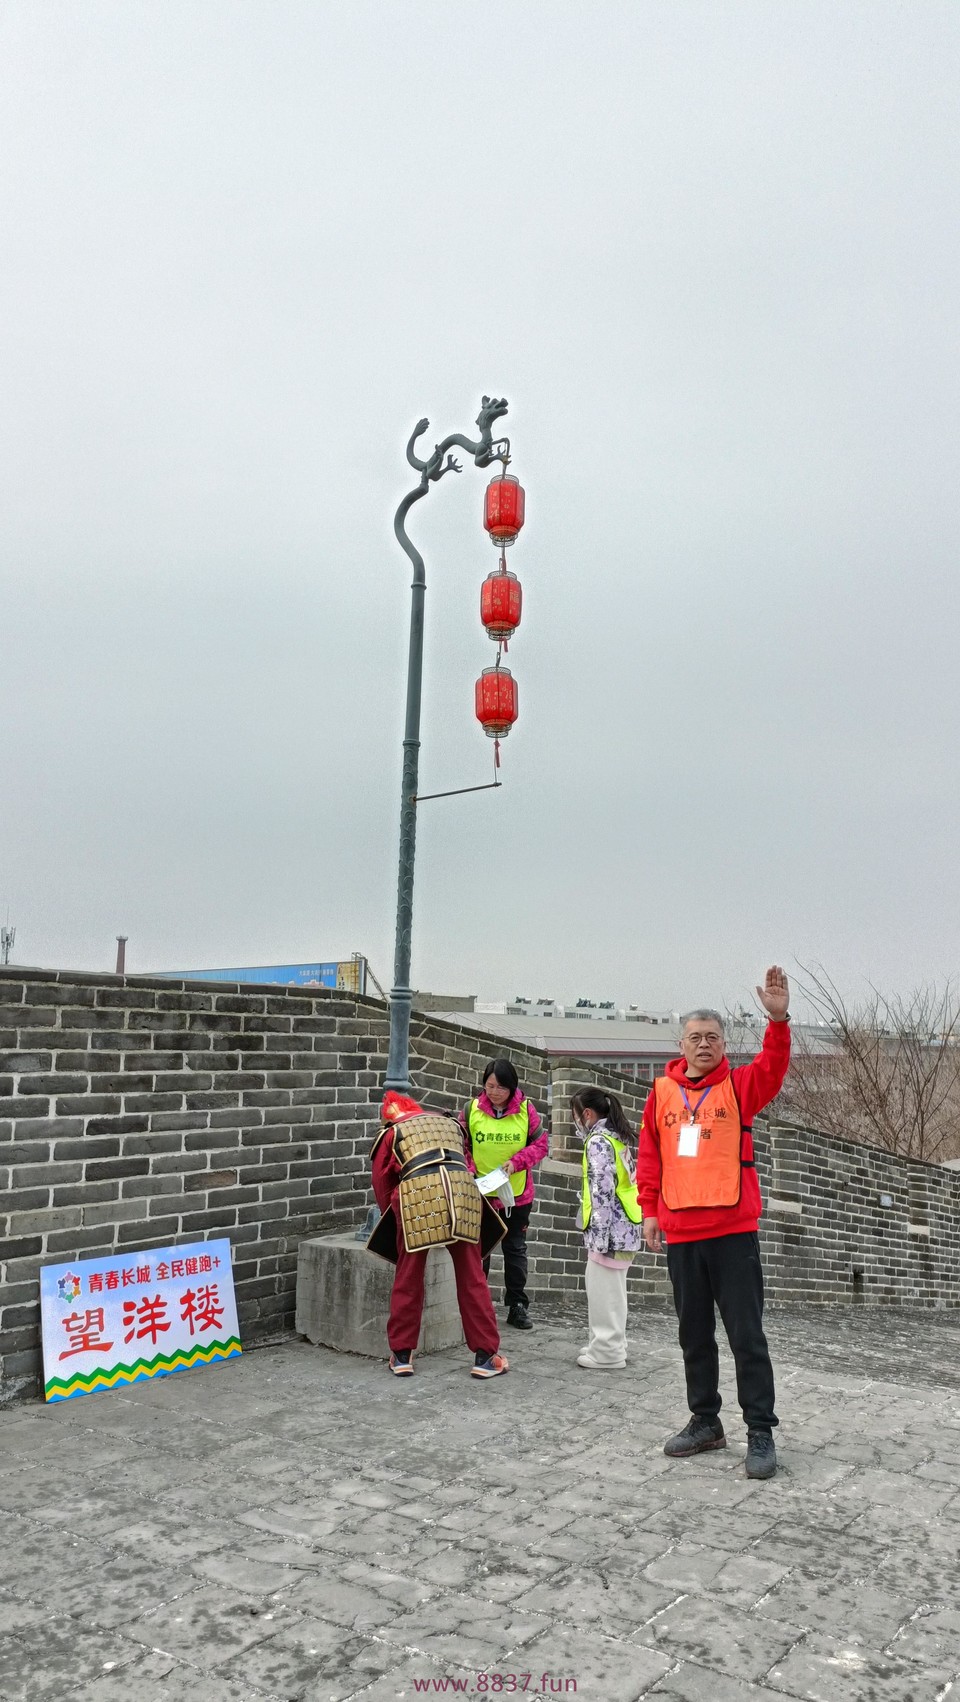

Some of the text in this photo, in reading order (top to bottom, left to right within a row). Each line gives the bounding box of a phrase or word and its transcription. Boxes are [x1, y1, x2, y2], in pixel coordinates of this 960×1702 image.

[486, 1133, 521, 1142] 青春长城
[89, 1256, 221, 1292] 青春长城 全民健跑+
[58, 1284, 224, 1361] 望洋楼
